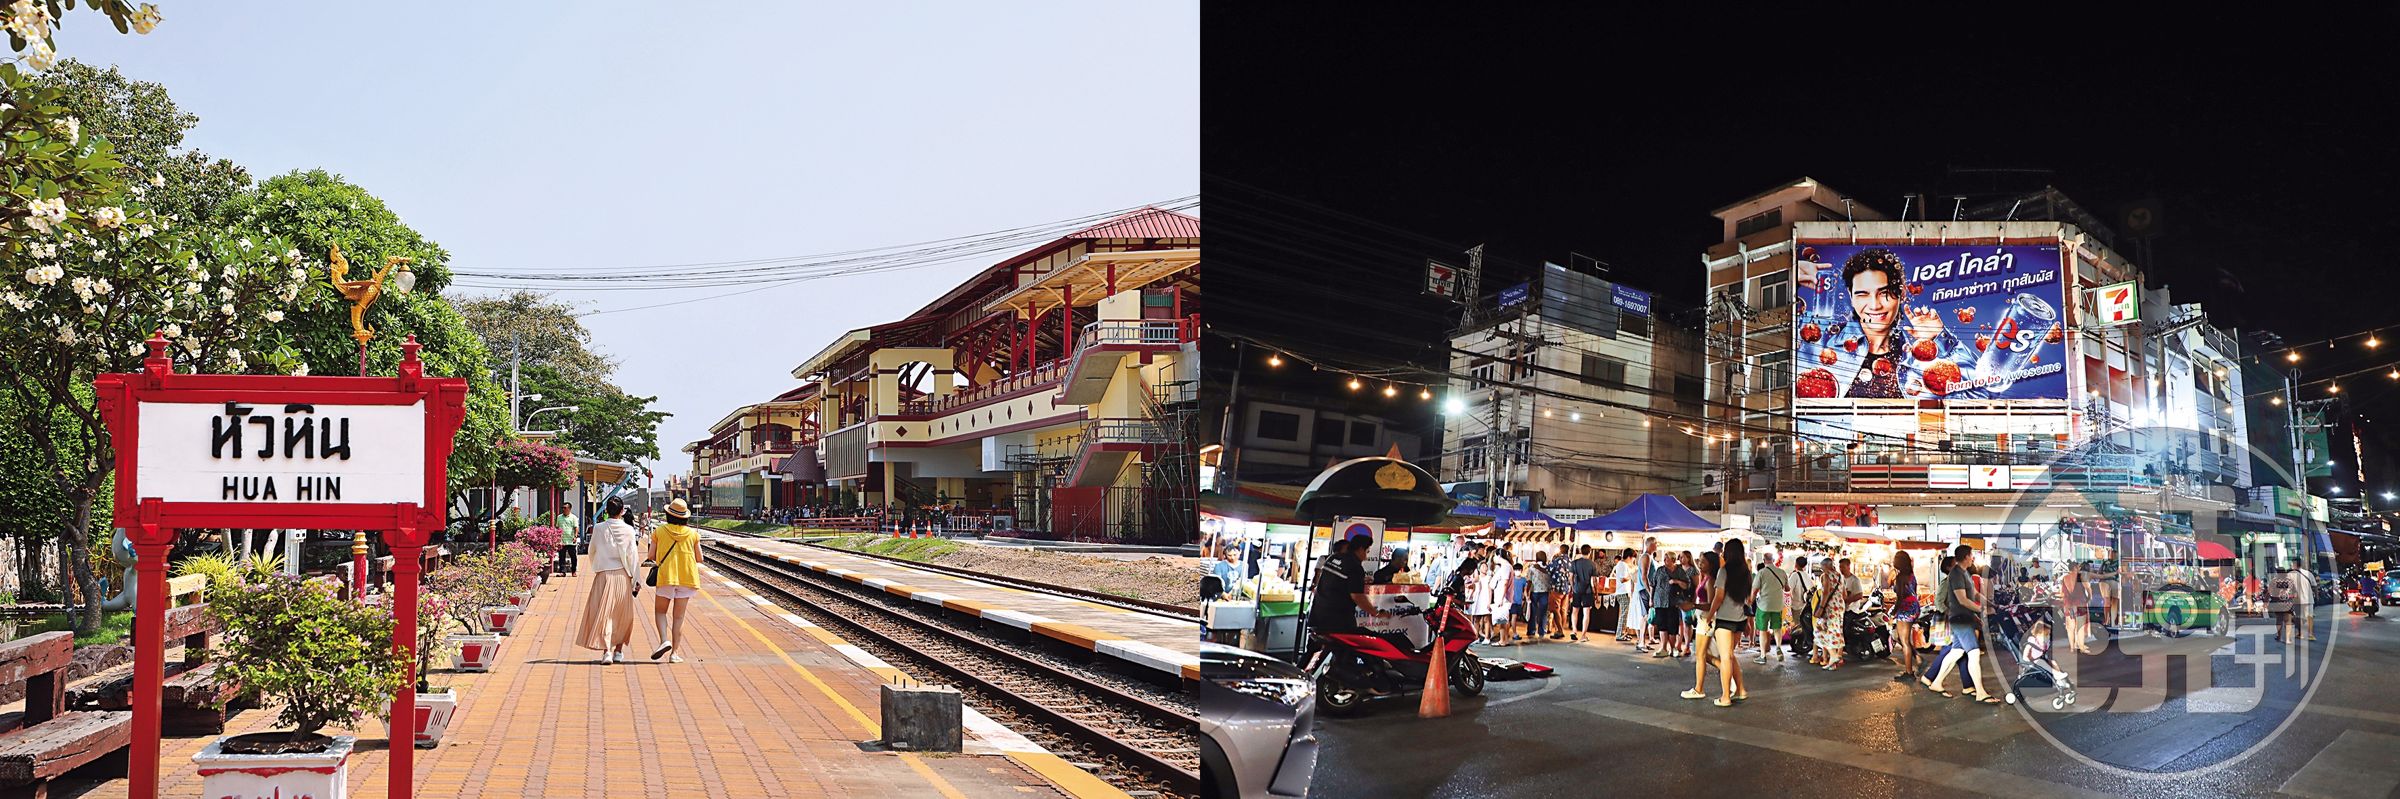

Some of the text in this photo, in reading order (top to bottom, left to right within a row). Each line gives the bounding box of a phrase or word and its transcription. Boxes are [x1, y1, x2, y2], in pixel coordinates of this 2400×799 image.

[1912, 248, 2014, 282] เอส โคล่า
[1433, 266, 1453, 295] 7
[2003, 270, 2054, 292] ทุกสัมผัส
[2105, 288, 2128, 321] 7
[1945, 362, 2061, 393] Born to be Awesome
[211, 401, 351, 461] หัวหิน
[222, 476, 341, 500] HUA HIN
[1983, 467, 1997, 487] 7
